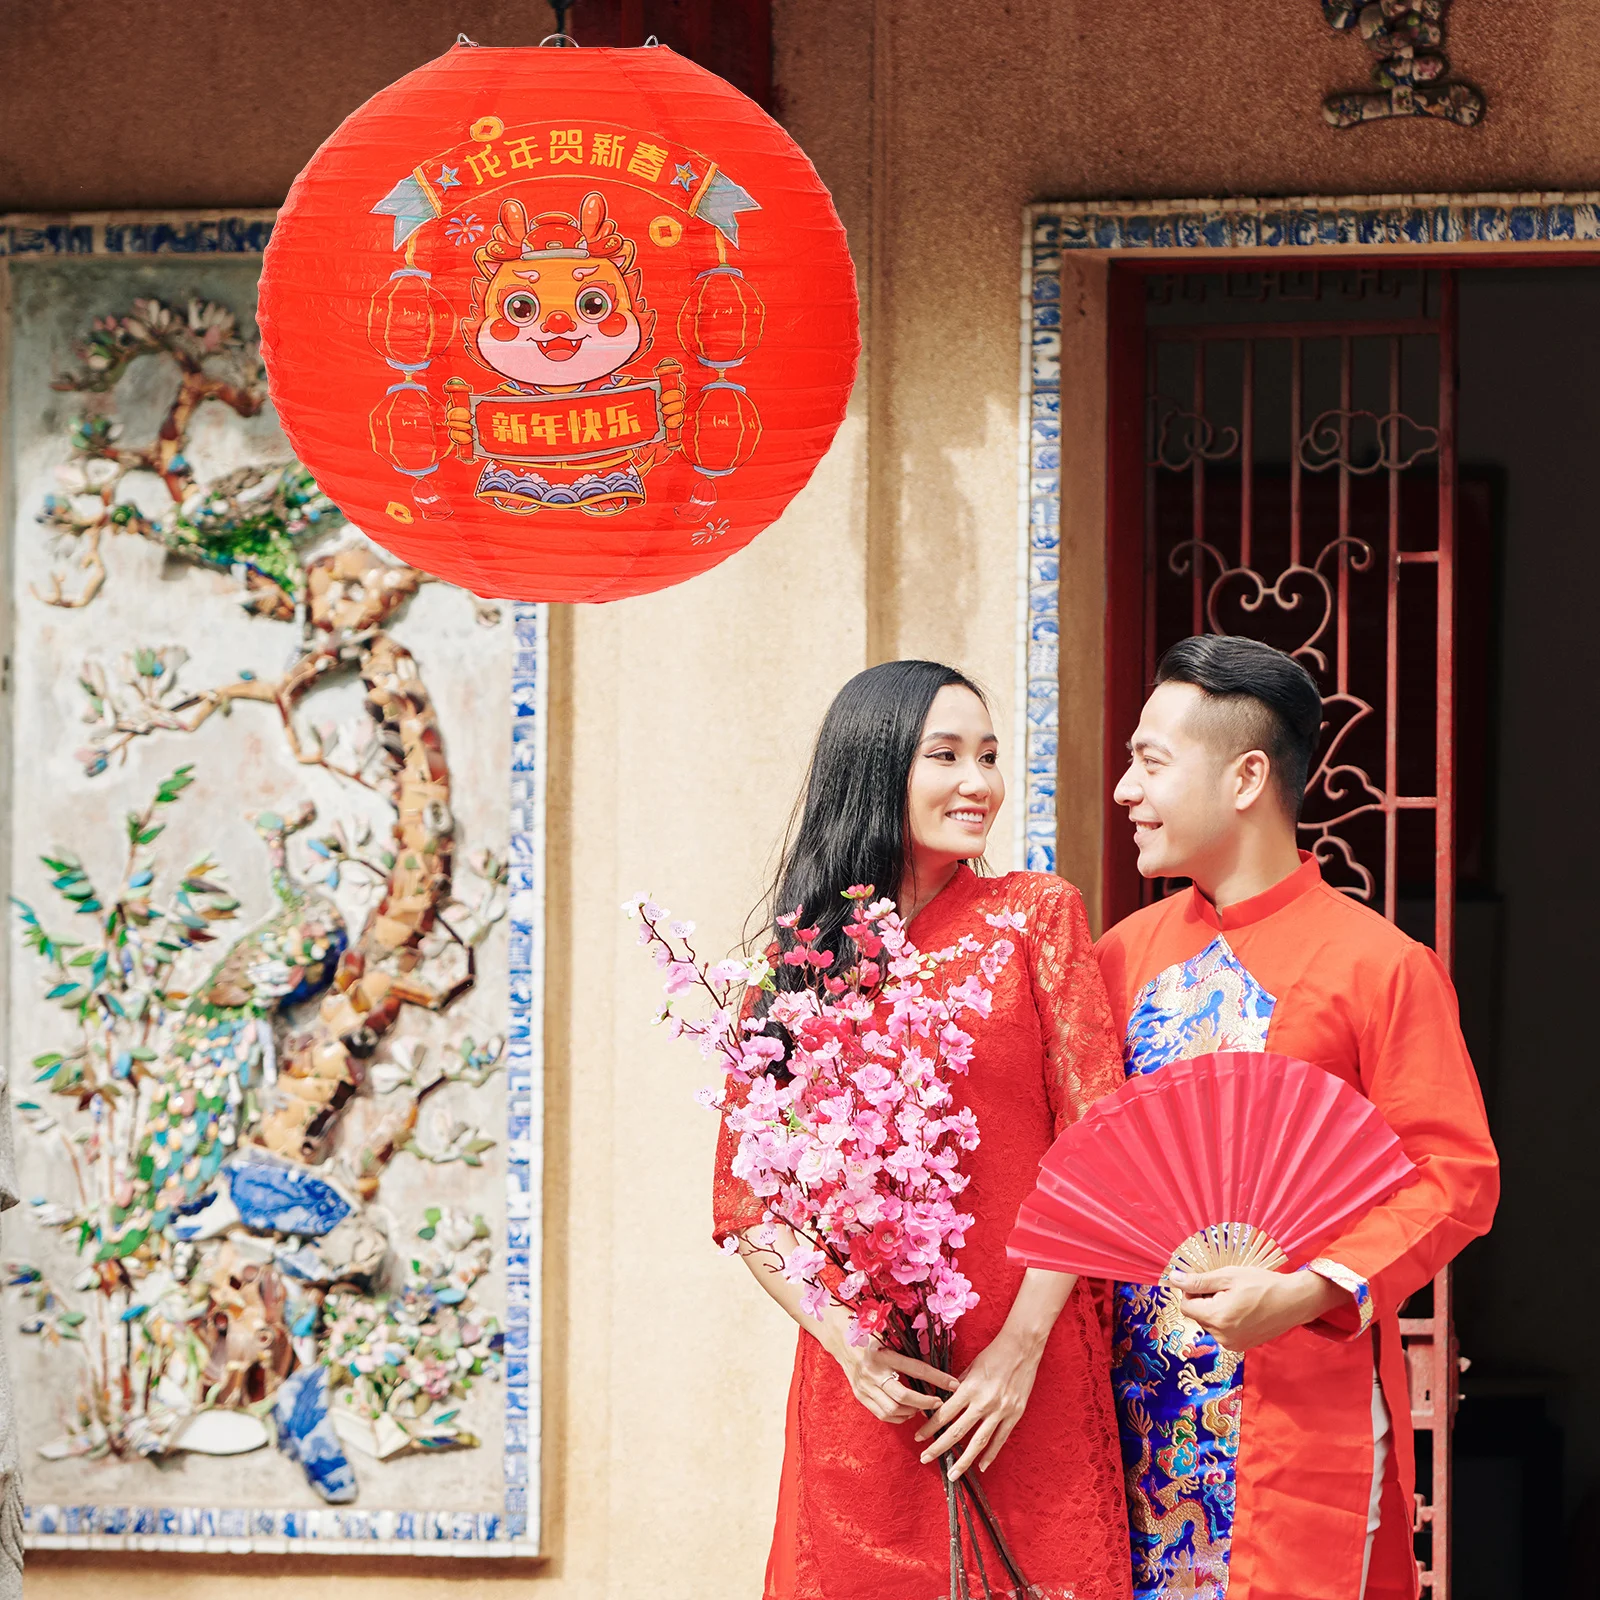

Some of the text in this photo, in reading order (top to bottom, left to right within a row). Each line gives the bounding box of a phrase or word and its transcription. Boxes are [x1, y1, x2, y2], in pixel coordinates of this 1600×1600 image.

[464, 129, 669, 185] 龙年贺新春
[492, 402, 641, 445] 新年快乐
